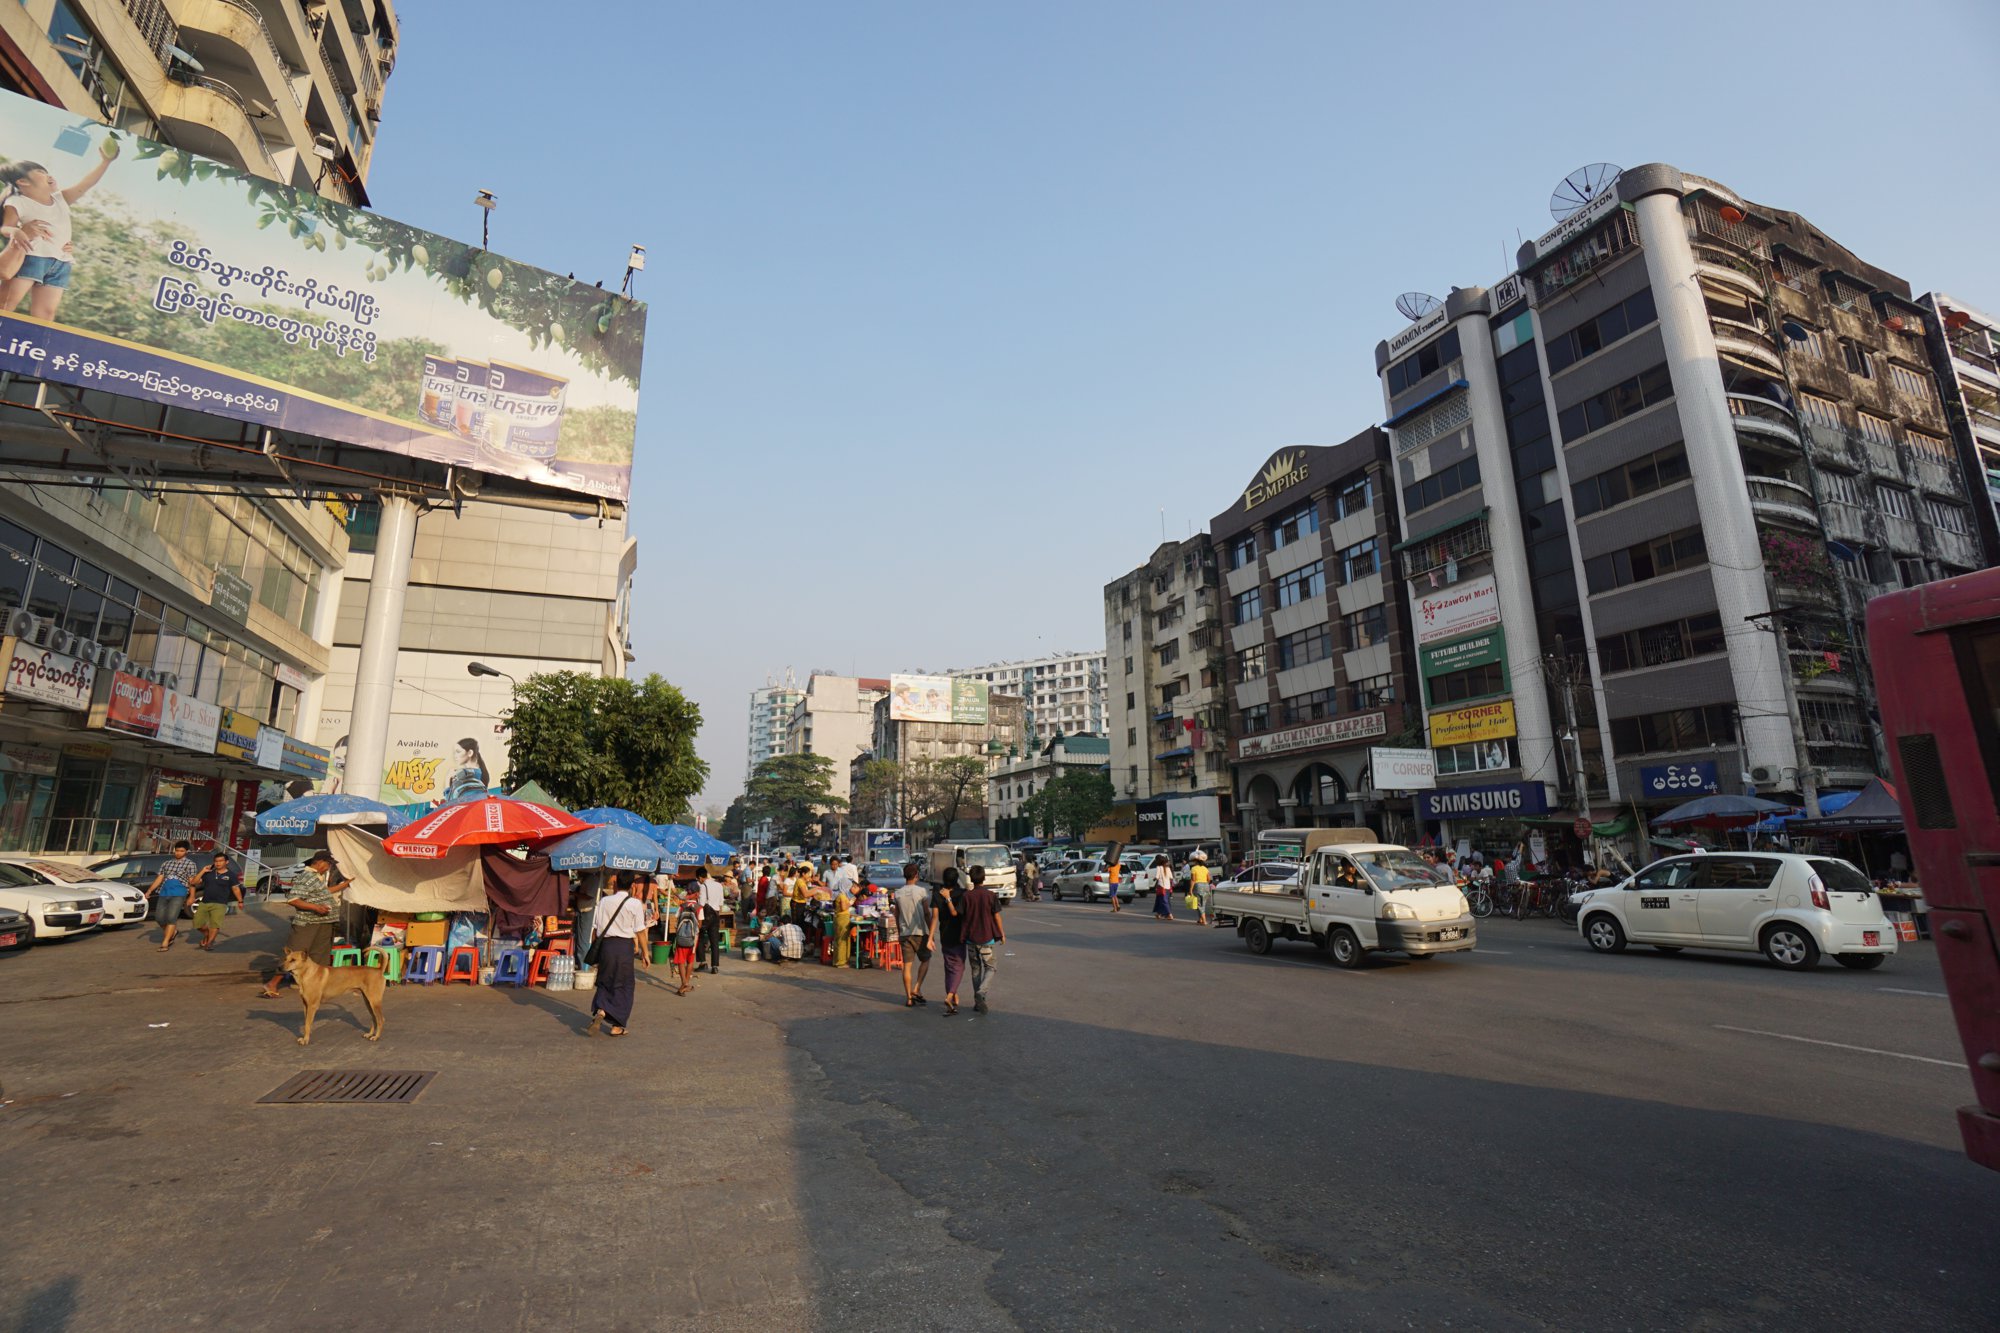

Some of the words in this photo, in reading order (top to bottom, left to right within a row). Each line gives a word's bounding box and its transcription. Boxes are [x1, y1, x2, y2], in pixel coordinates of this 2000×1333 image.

[1540, 192, 1613, 248] CONSTRUCTION
[169, 240, 380, 325] စိတ်သွားတိုင်းကိုယ်ပါပြီး
[154, 276, 377, 363] ဖြစ်ချင်တာတွေလုပ်နိုင်ဖို့
[52, 353, 79, 372] နှင့်
[492, 394, 558, 416] Ensure
[587, 479, 622, 493] Abbott
[1474, 586, 1494, 598] Mart
[1431, 645, 1458, 659] FUTURE
[1459, 638, 1490, 652] BUILDER
[182, 702, 196, 721] Dr.
[200, 708, 216, 728] Skin
[1458, 704, 1503, 721] CORNER
[1271, 723, 1333, 745] ALUMINIUM
[1335, 714, 1384, 734] EMPIRE
[1364, 726, 1384, 735] CENTRE
[1435, 720, 1482, 734] Professional
[396, 739, 439, 749] Available
[1393, 762, 1433, 776] CORNER
[1430, 789, 1521, 814] SAMSUNG
[265, 815, 309, 831] တယ်လီနော
[1138, 812, 1164, 822] SONY
[559, 852, 598, 867] တယ်လီနော
[612, 855, 651, 870] telenor
